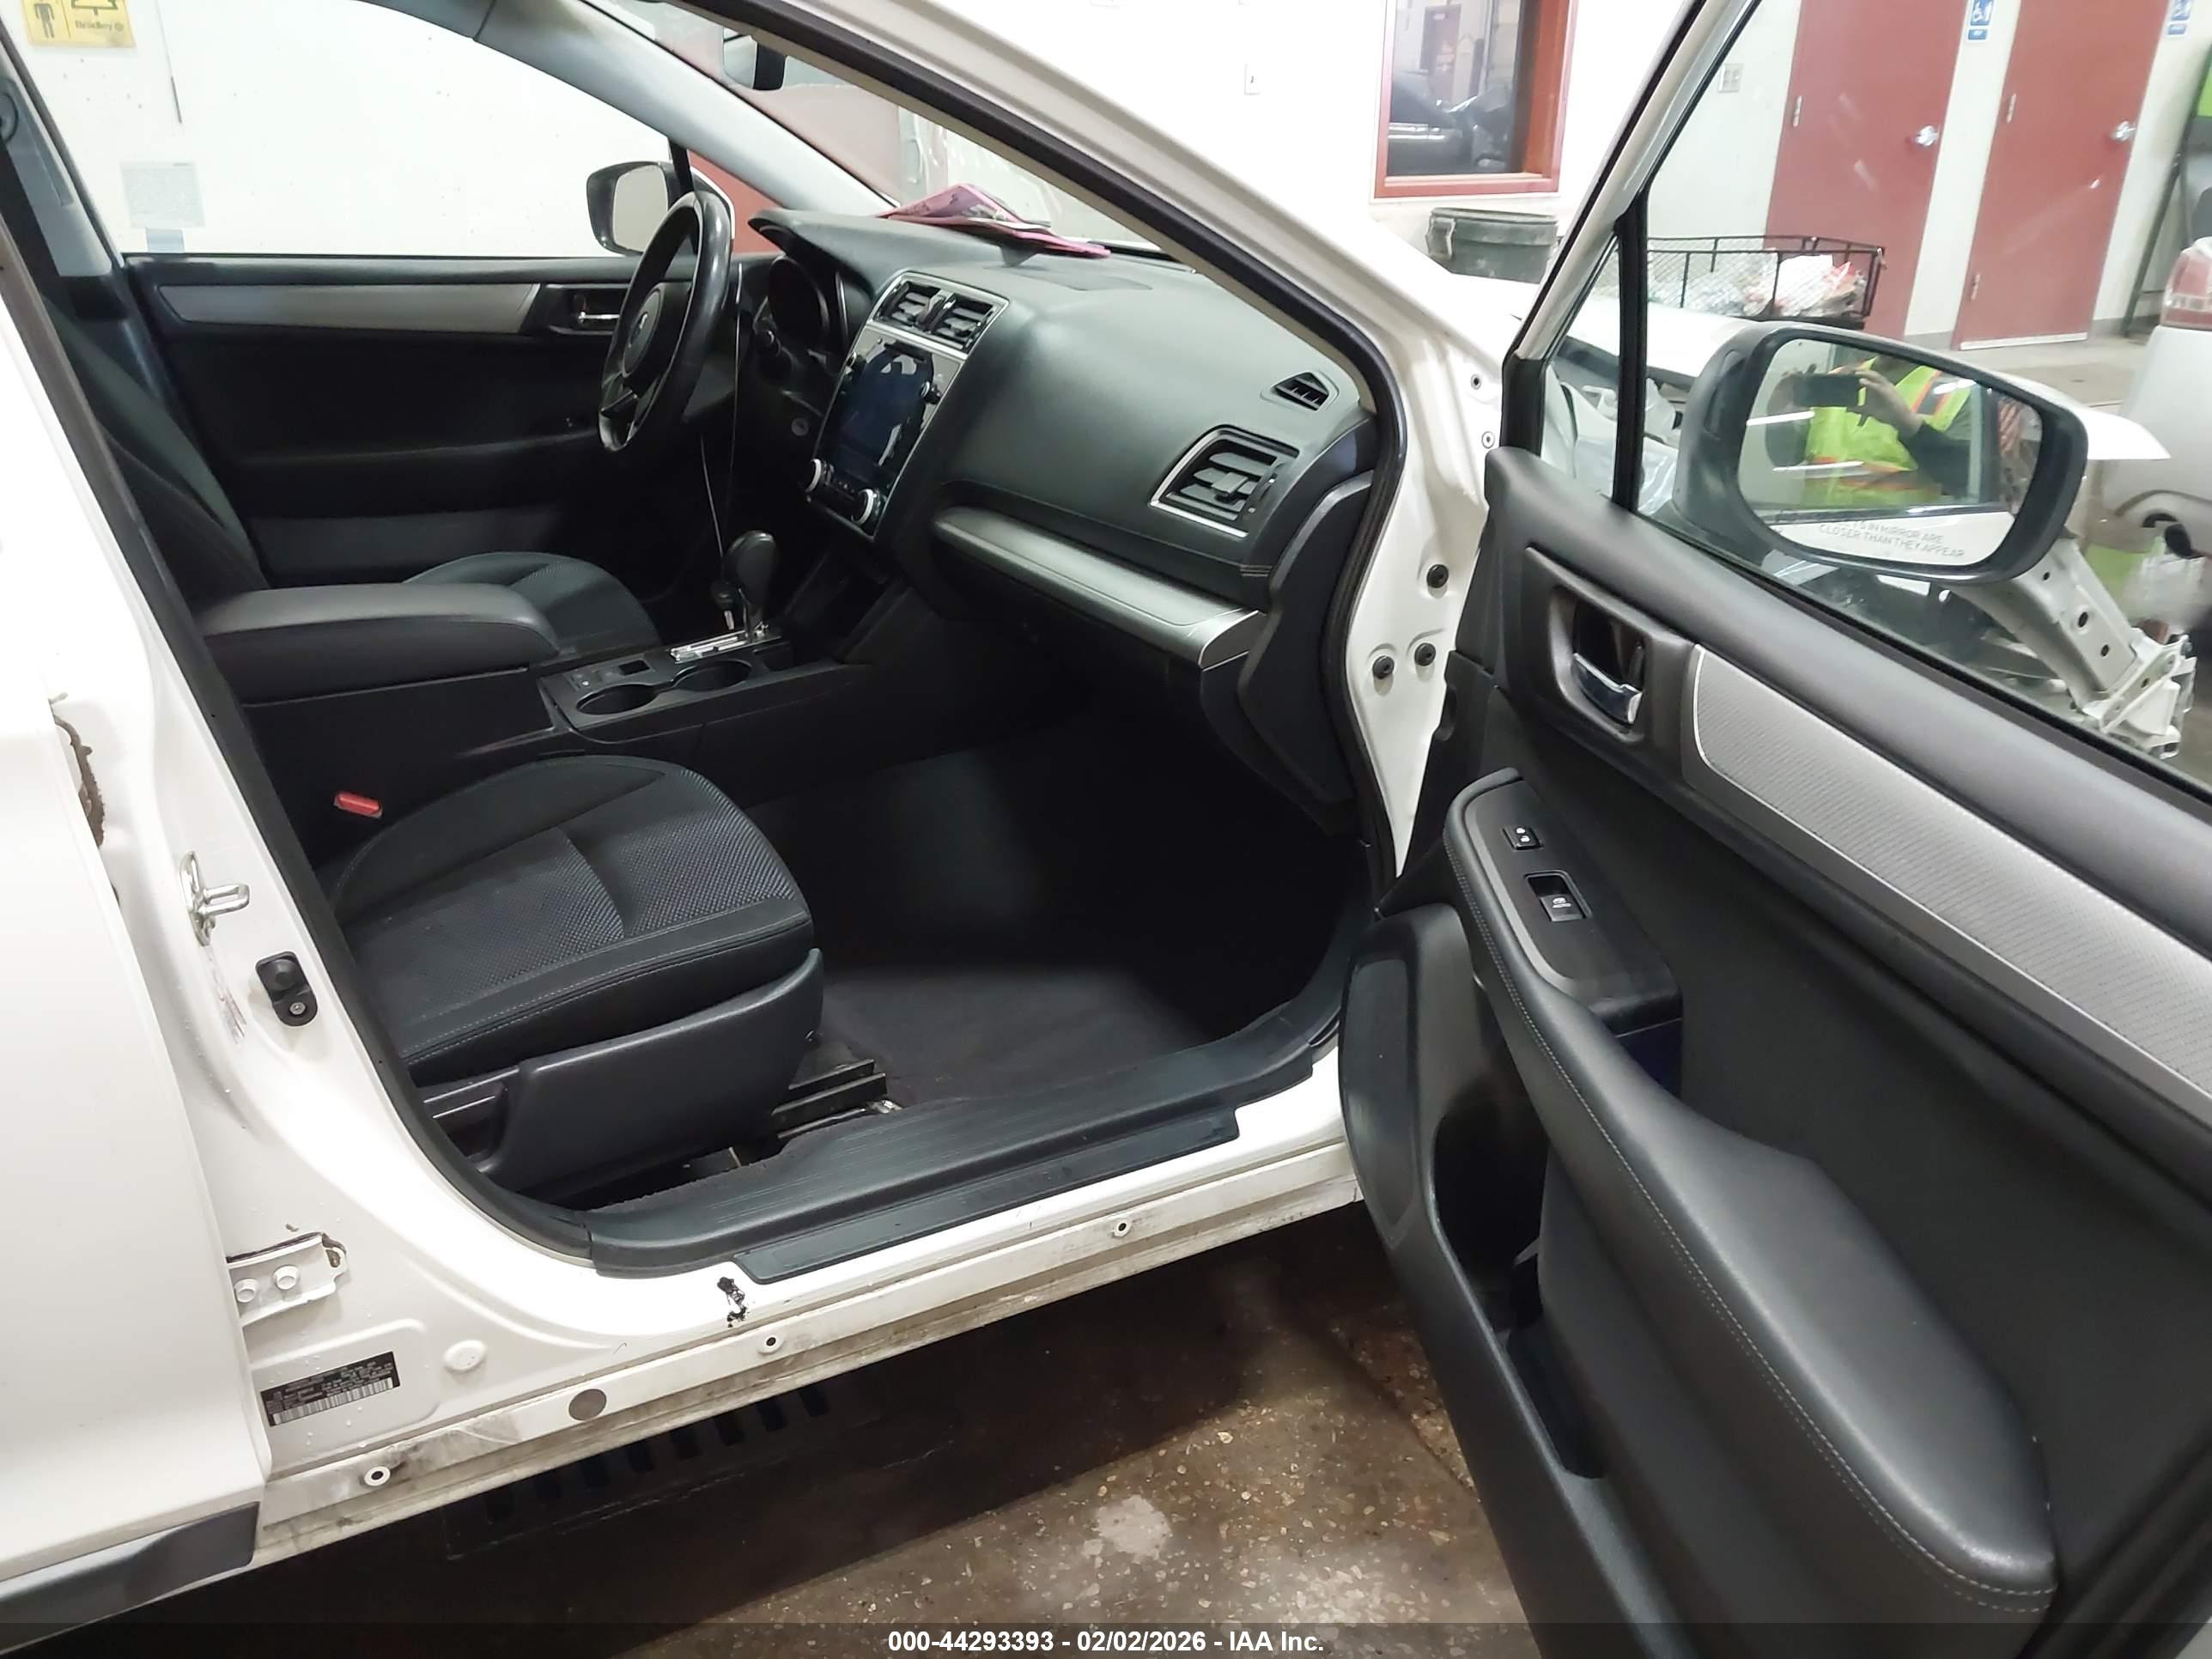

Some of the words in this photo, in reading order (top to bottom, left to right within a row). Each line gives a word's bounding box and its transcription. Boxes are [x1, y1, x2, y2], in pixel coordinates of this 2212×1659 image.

[1820, 524, 1861, 538] CLOSER
[1862, 532, 1892, 544] THAN
[1892, 538, 1921, 550] THEY
[1921, 544, 1966, 557] APPEAR
[1880, 525, 1921, 538] MIRROR
[1923, 533, 1944, 543] ARE
